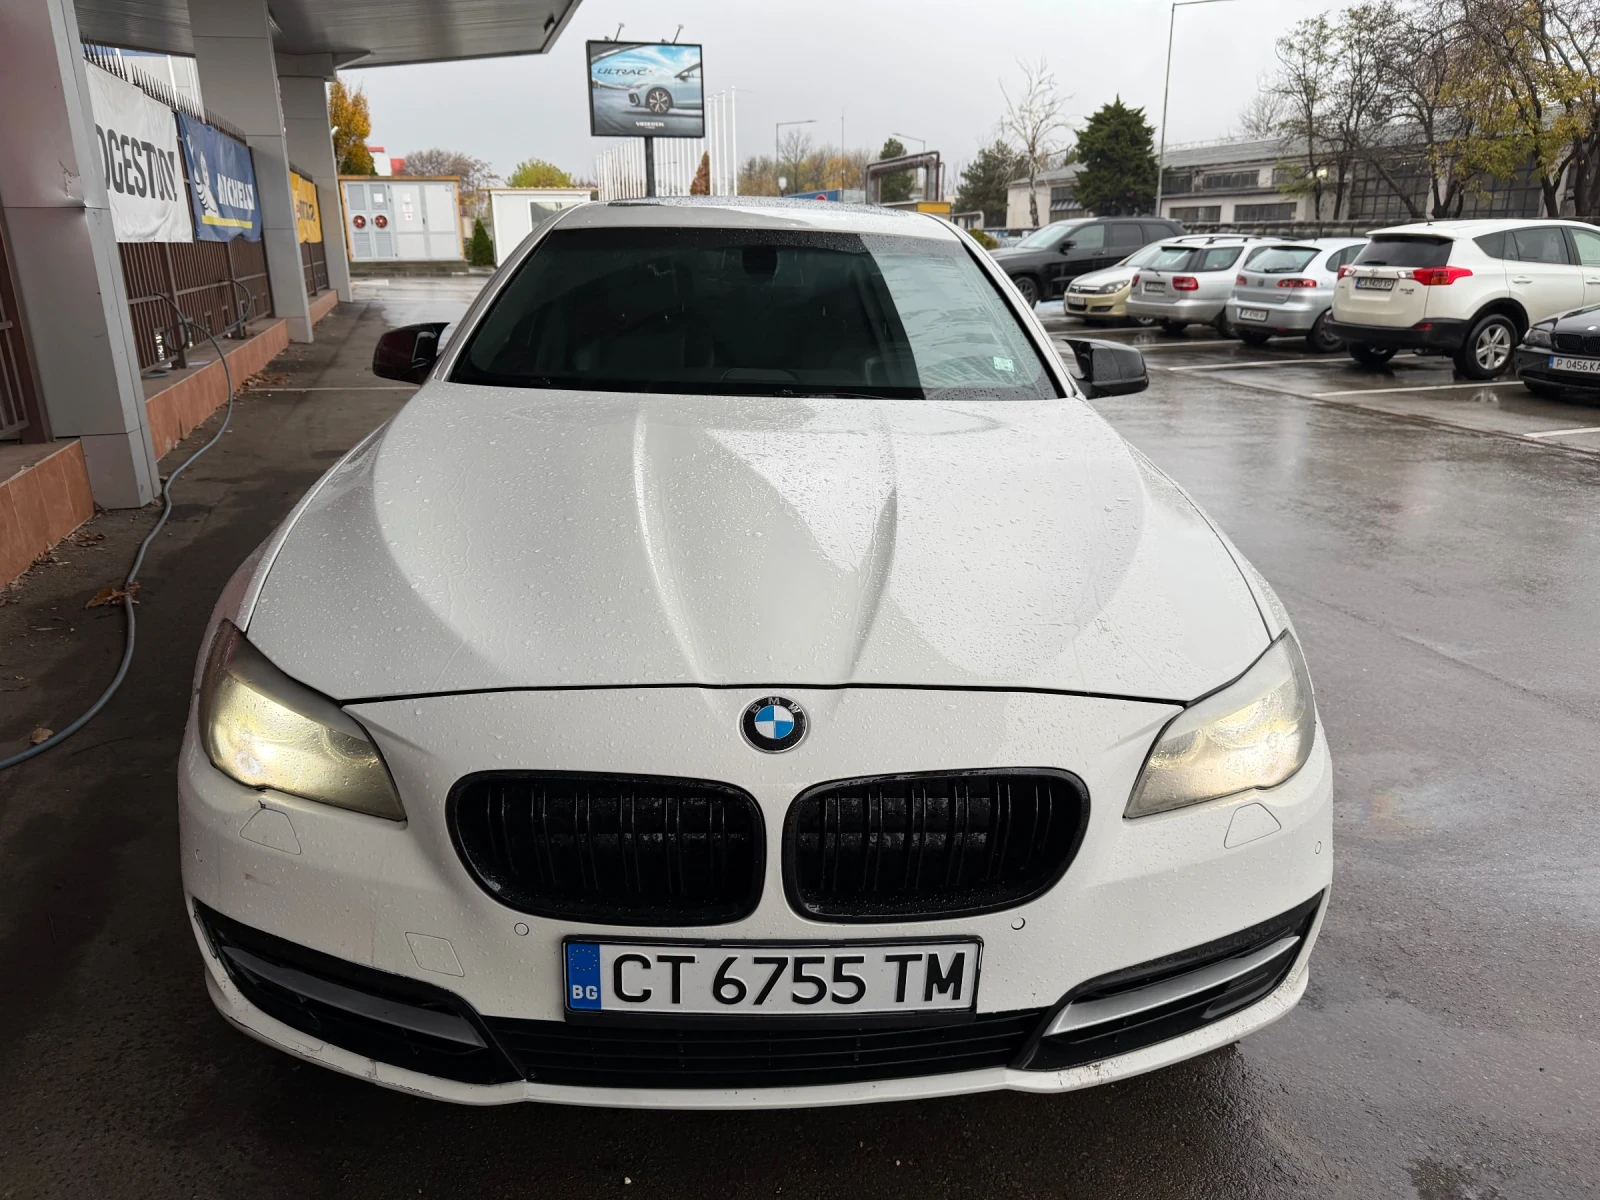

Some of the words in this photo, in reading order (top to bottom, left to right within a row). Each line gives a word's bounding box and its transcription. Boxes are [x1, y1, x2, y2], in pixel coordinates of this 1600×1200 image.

[1556, 359, 1563, 368] P
[1566, 360, 1588, 371] 0456
[748, 697, 801, 714] BMW
[613, 953, 696, 1004] CT
[712, 956, 867, 1005] 6755
[885, 952, 966, 1003] TM
[572, 984, 598, 1000] BG
